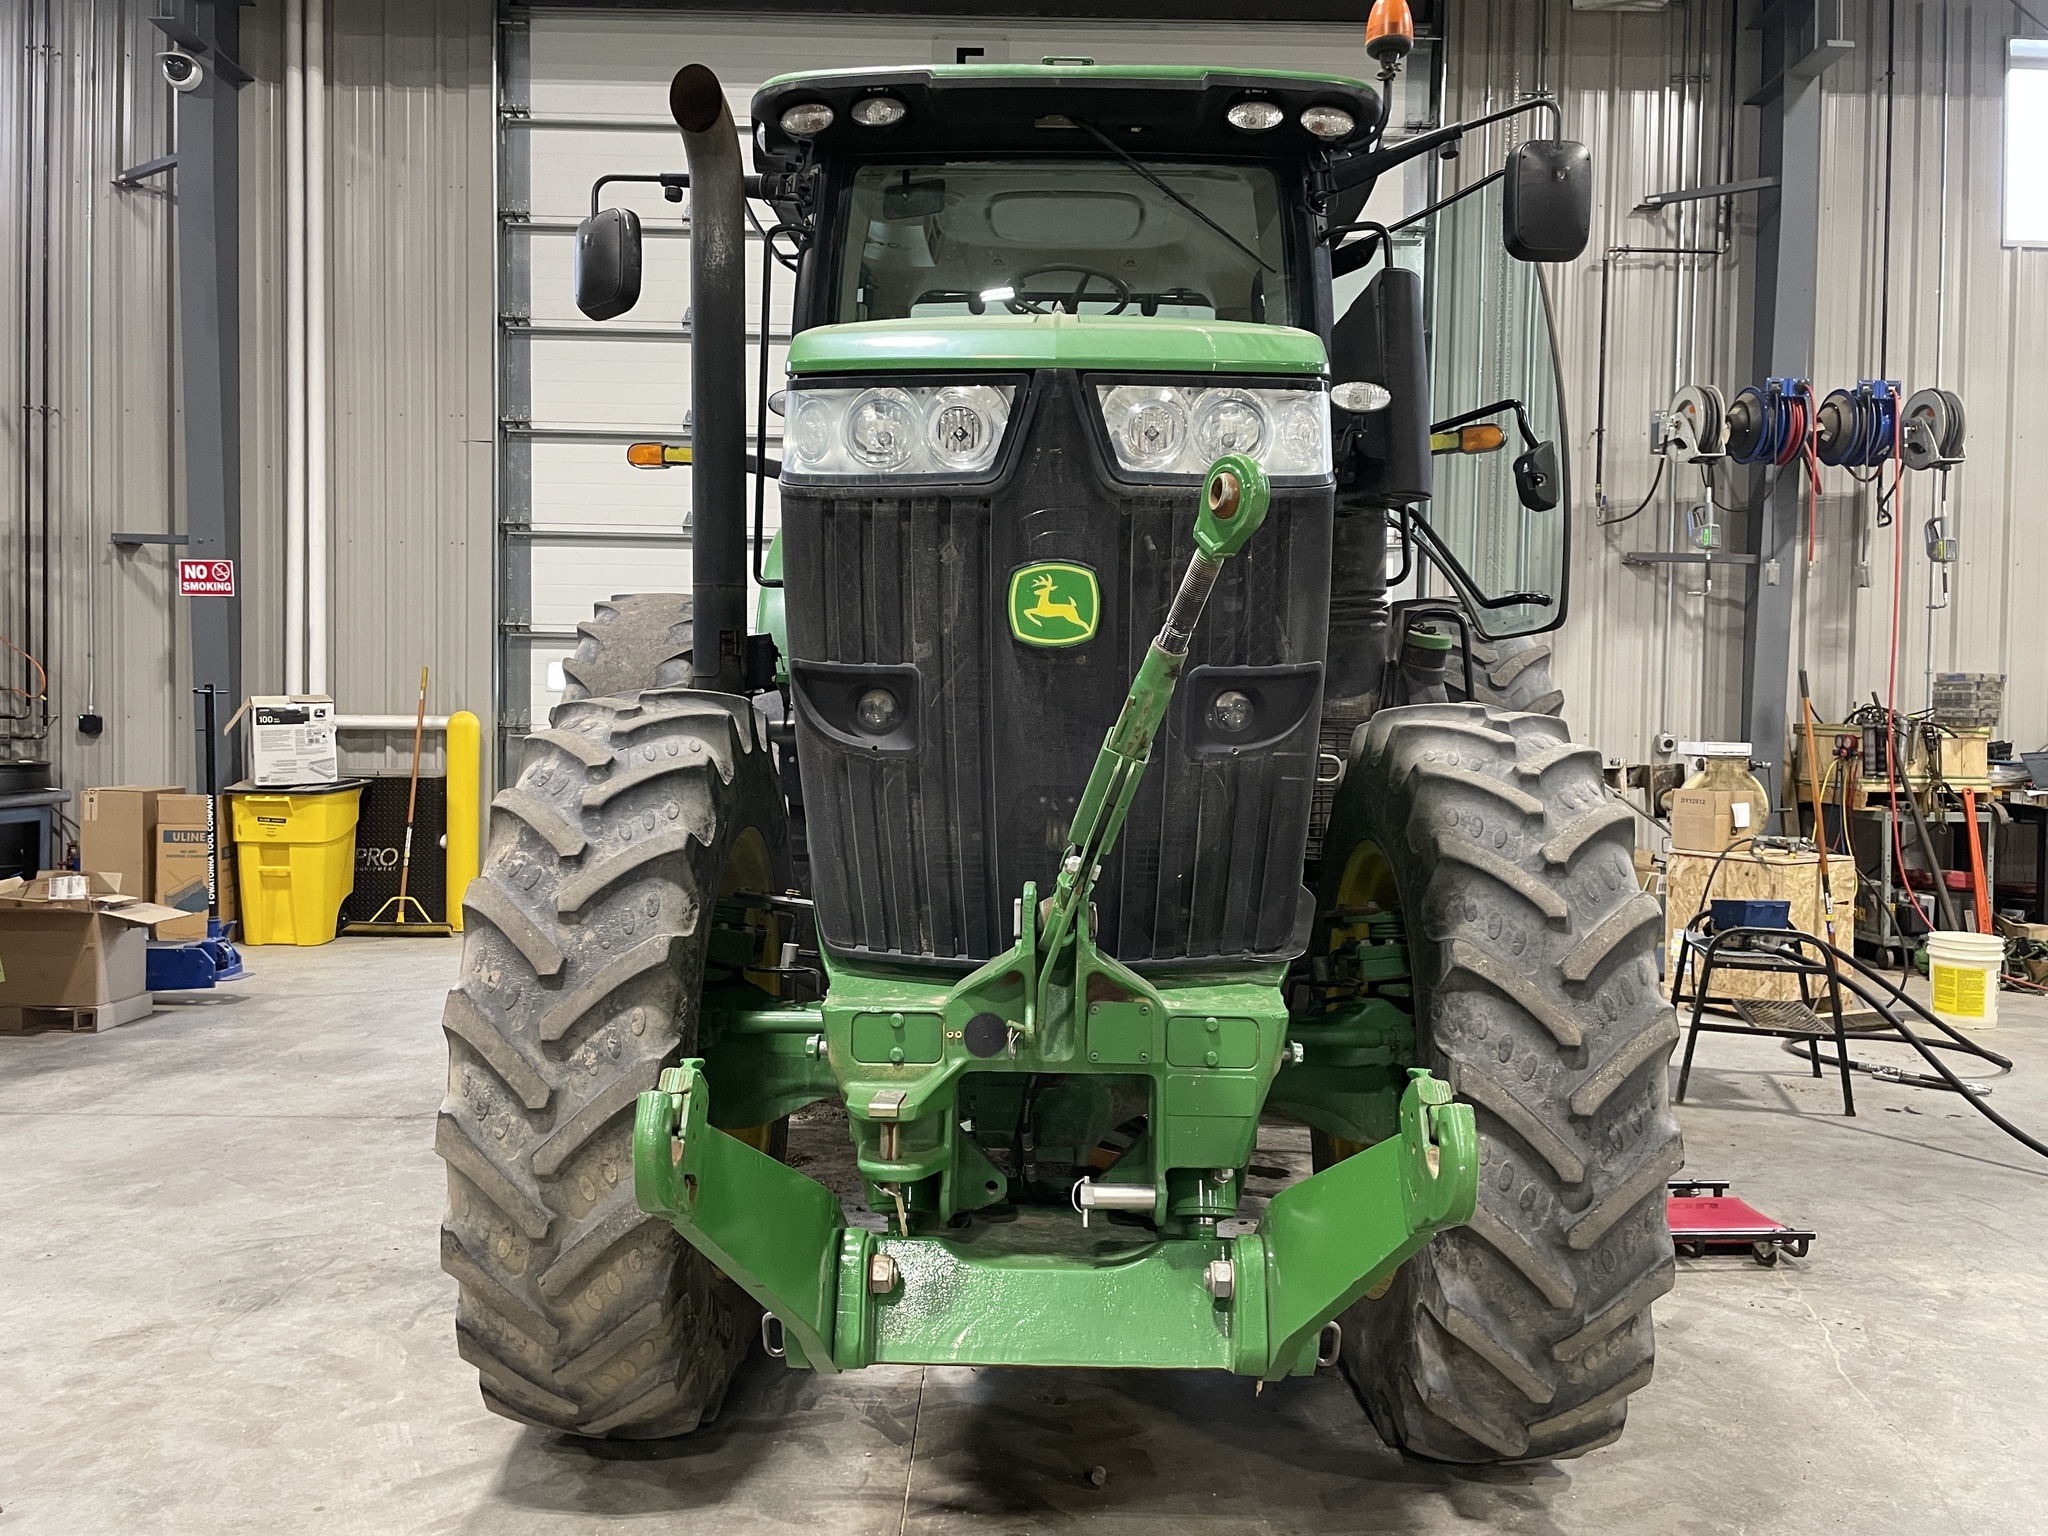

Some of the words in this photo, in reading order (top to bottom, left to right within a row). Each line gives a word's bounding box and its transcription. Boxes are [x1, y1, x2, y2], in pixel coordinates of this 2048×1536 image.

[185, 565, 207, 579] NO
[182, 581, 232, 592] SMOKING
[259, 715, 274, 724] 100
[206, 793, 214, 832] COMPANY
[173, 832, 205, 842] ULINE
[207, 832, 215, 855] TOOL
[356, 848, 398, 866] PRO
